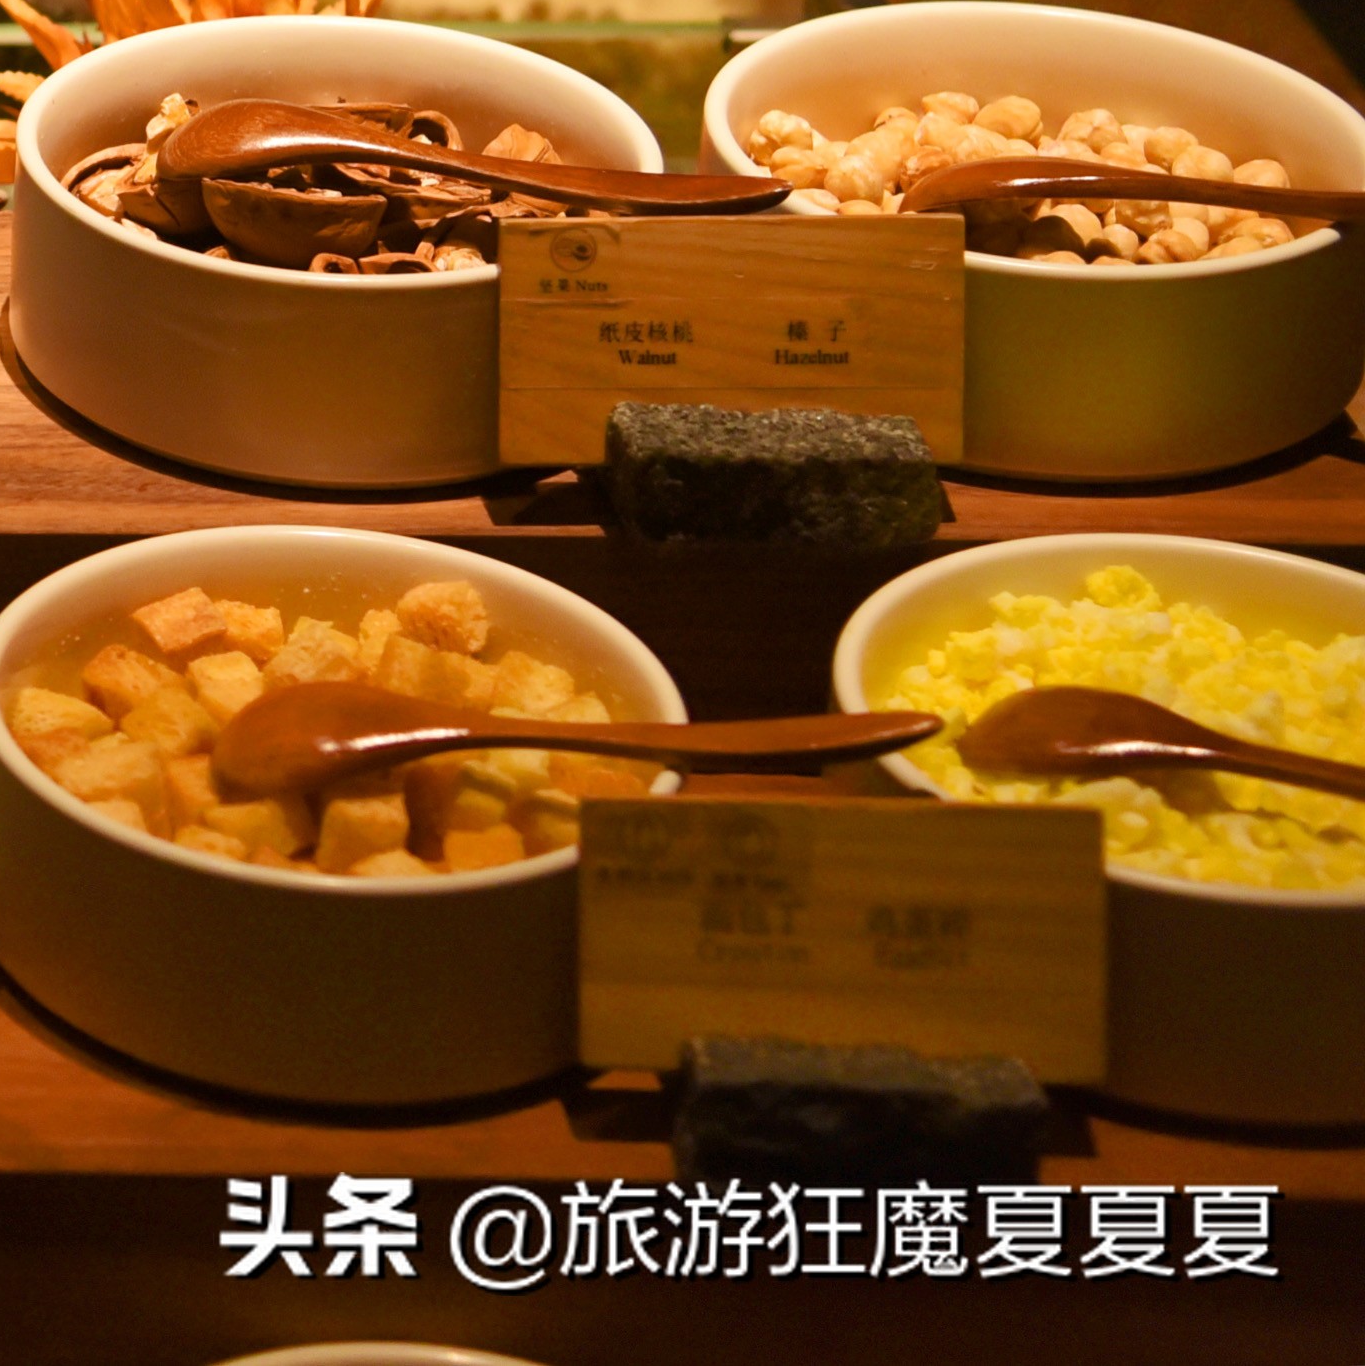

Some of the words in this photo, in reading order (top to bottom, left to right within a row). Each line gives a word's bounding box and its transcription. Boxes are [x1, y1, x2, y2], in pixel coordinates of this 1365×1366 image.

[576, 279, 608, 292] Nuts
[599, 321, 694, 344] 纸皮核桃
[618, 349, 677, 365] Walnut
[774, 349, 849, 365] Hazelnut
